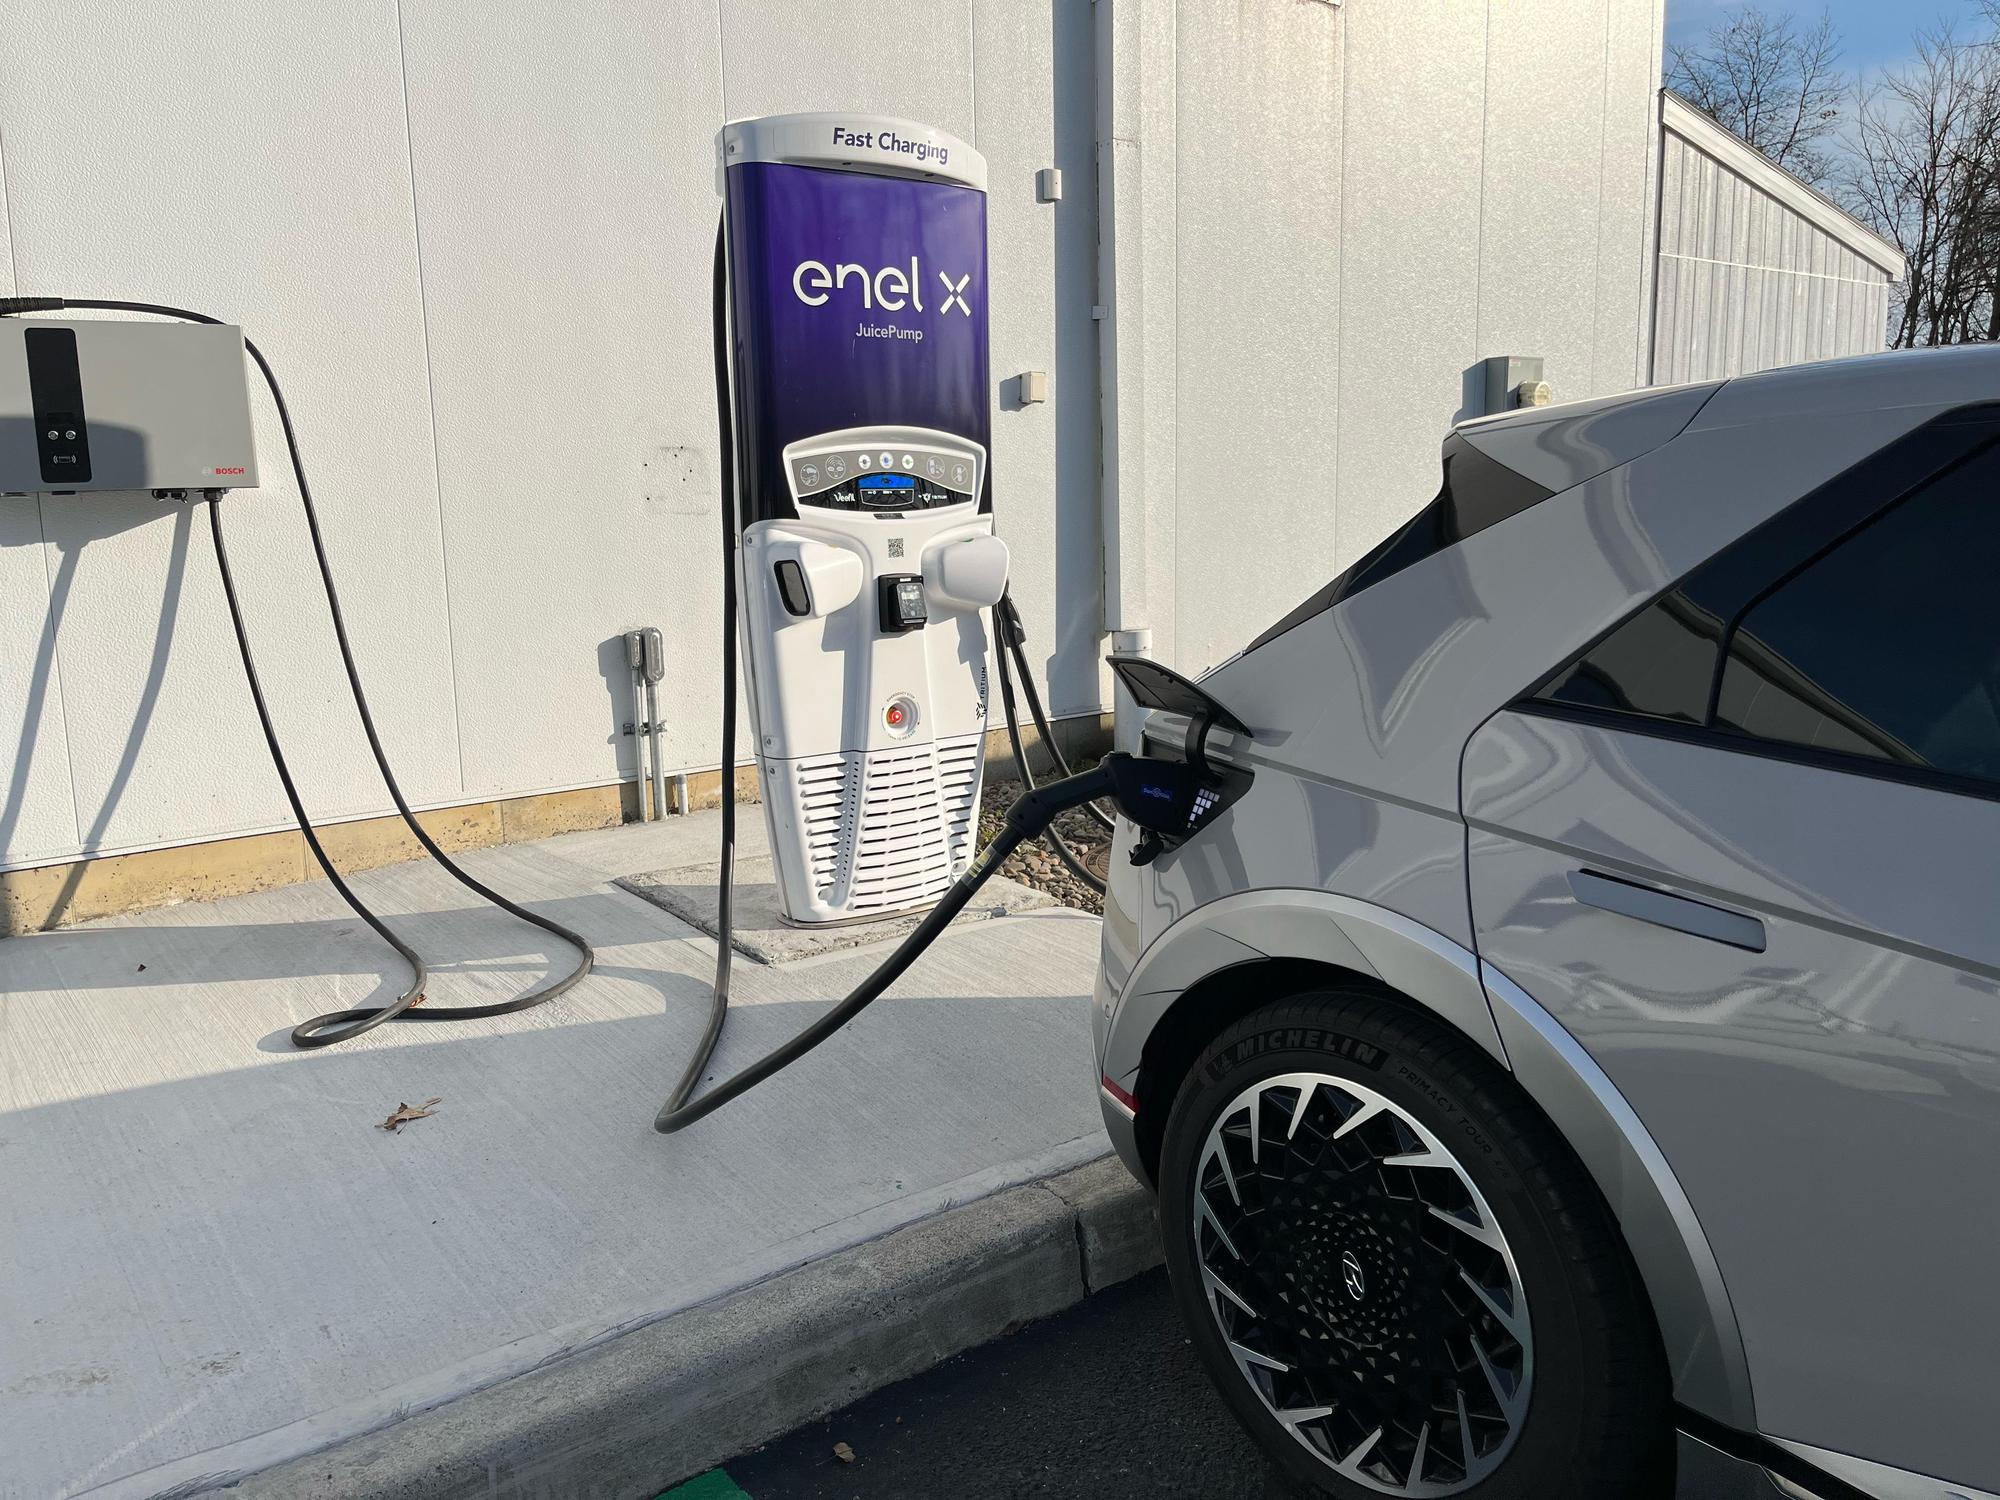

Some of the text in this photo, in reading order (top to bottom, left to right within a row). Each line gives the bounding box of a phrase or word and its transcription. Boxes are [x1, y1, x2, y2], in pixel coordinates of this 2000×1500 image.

[832, 127, 949, 164] Fast Charging
[792, 256, 924, 313] enel
[855, 323, 923, 344] JuicePump
[215, 467, 245, 475] BOSCH
[1235, 1029, 1380, 1064] MICHELIN
[1398, 1065, 1458, 1113] PRIMACY
[1457, 1117, 1493, 1154] TOUR
